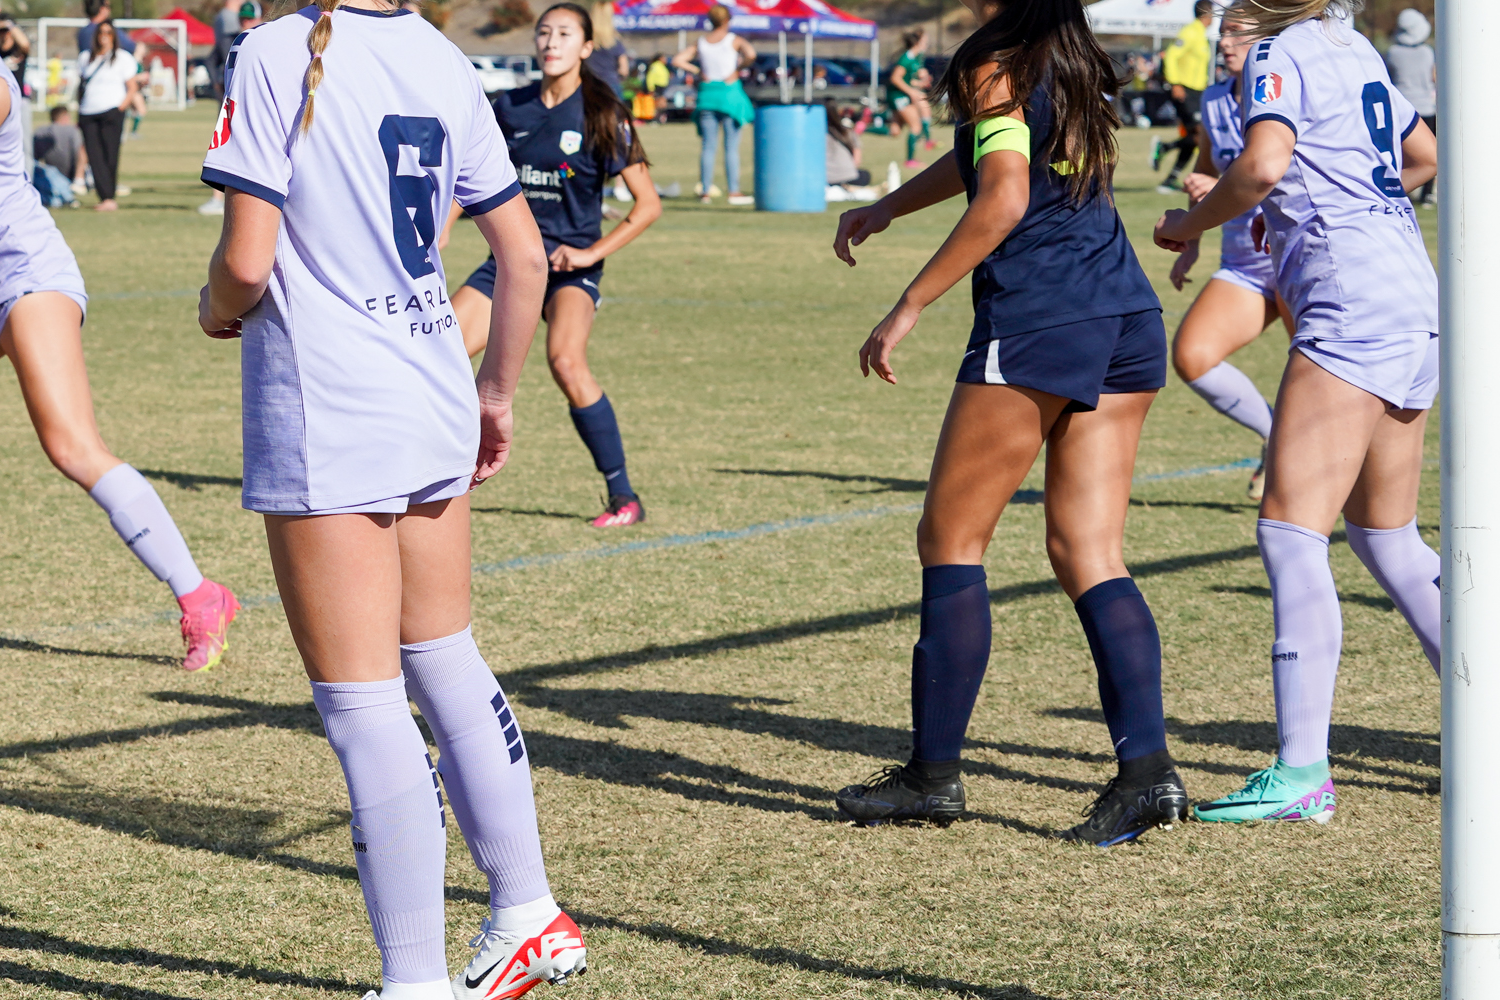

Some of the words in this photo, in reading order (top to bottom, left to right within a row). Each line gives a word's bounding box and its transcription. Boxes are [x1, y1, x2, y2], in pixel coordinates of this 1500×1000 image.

[378, 114, 446, 280] 6
[517, 164, 563, 188] liant
[1361, 81, 1407, 198] 9
